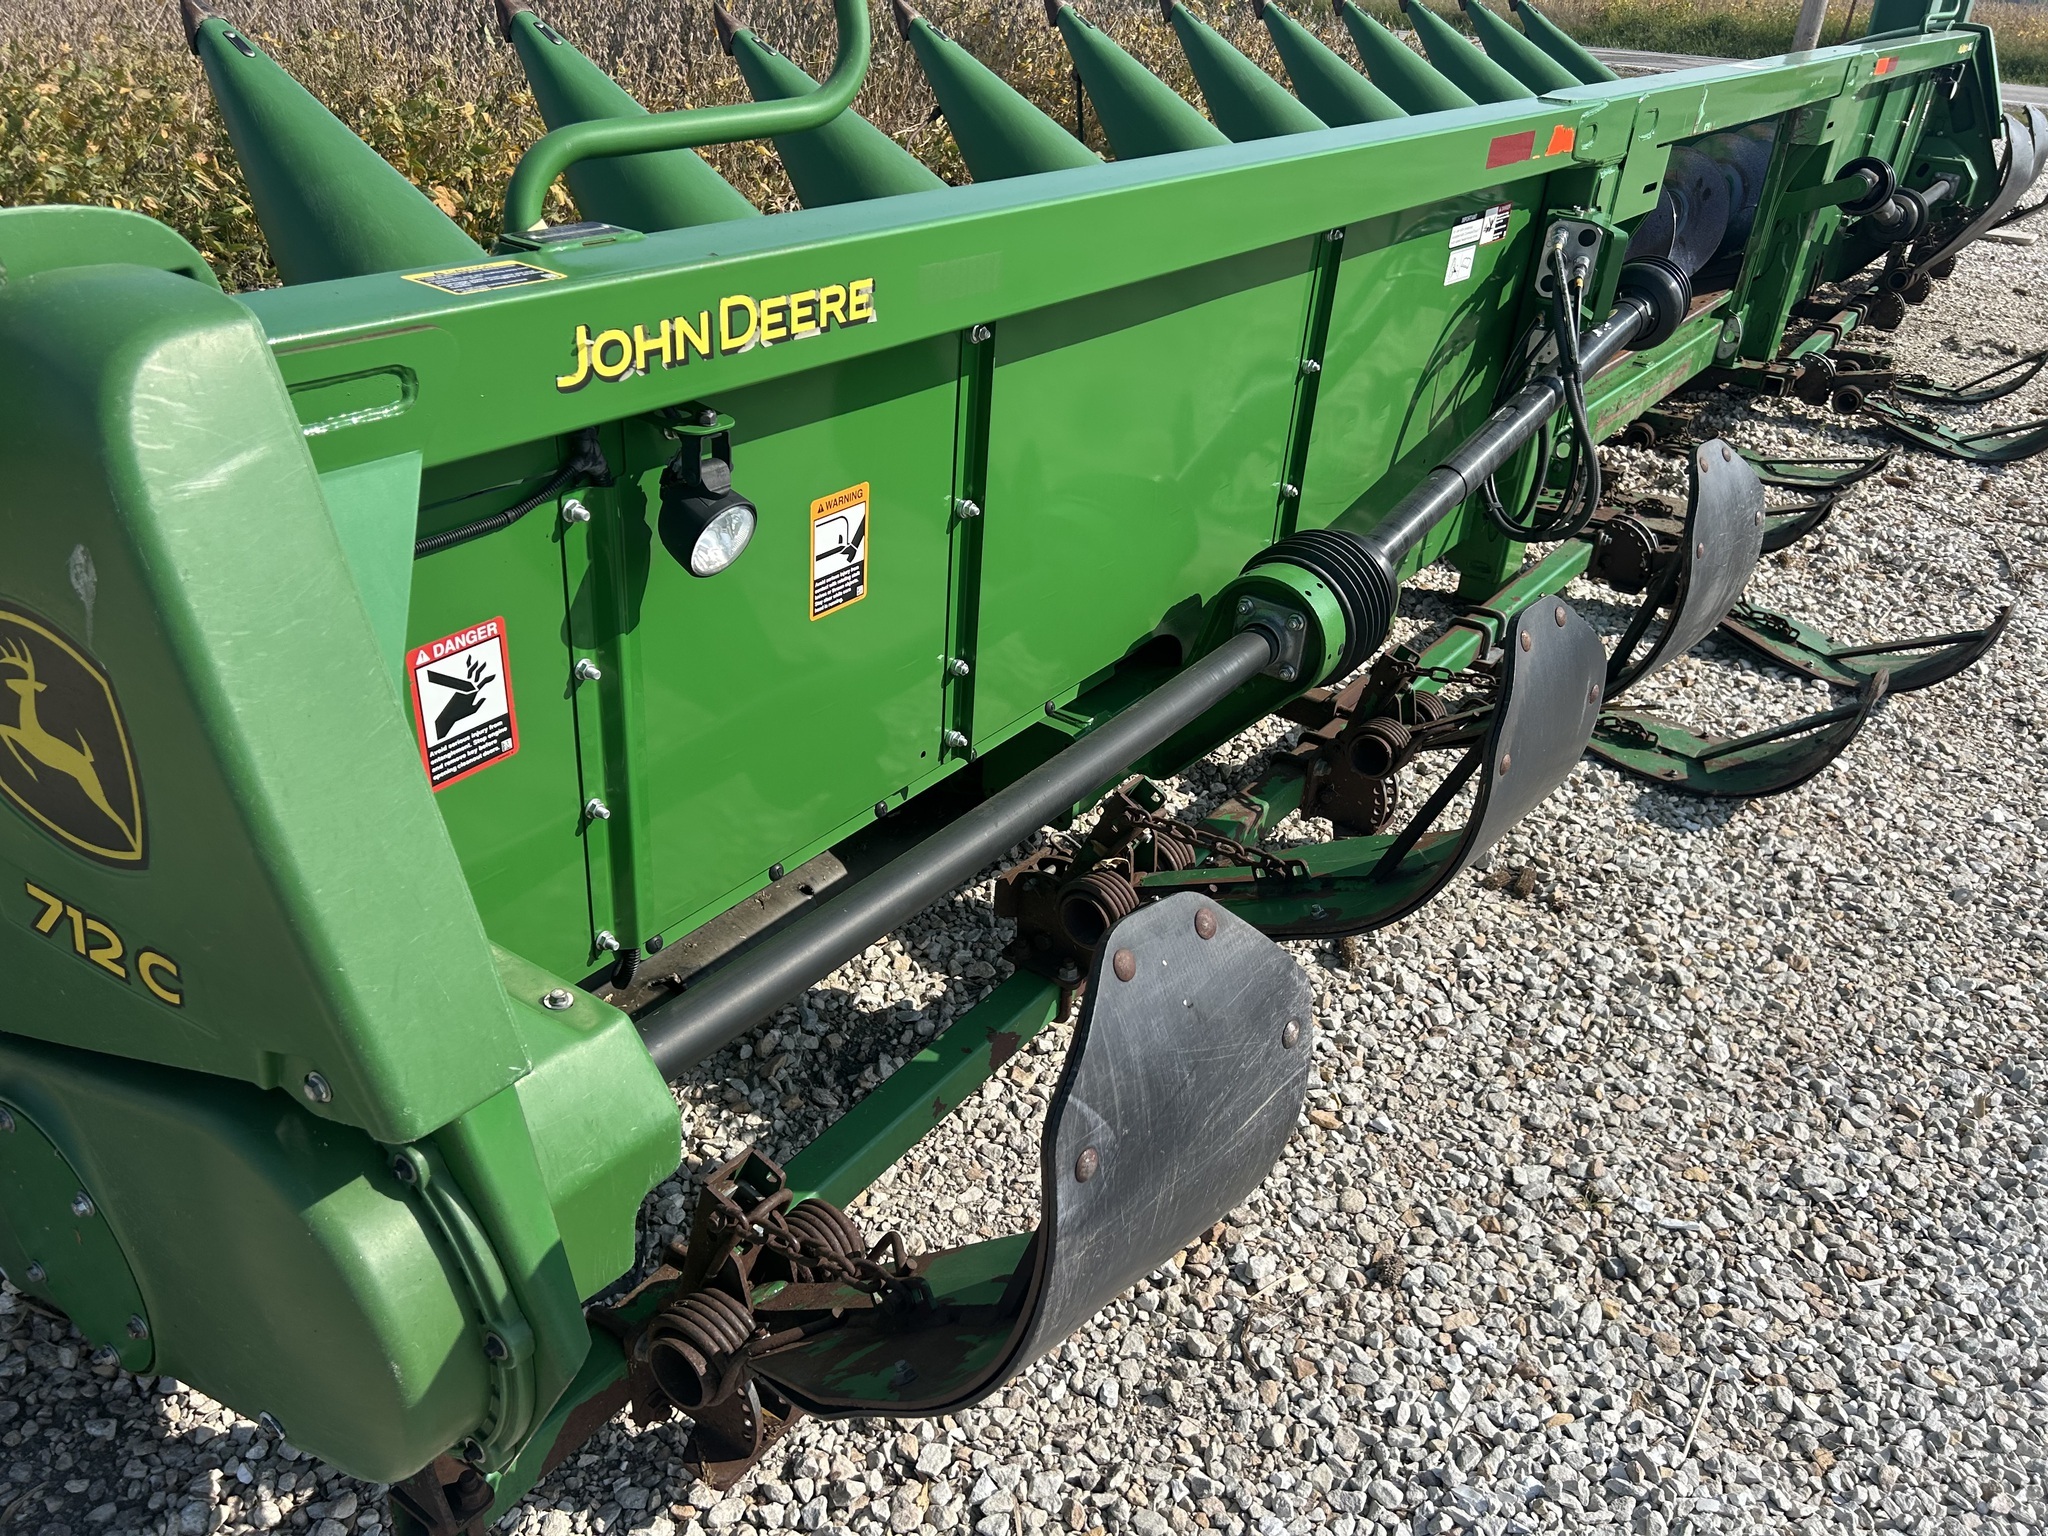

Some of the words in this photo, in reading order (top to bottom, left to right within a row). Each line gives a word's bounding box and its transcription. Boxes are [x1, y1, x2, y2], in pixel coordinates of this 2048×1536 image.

[556, 310, 711, 391] JOHN
[719, 278, 876, 354] DEERE
[825, 489, 863, 510] WARNING
[433, 622, 498, 658] DANGER
[430, 744, 448, 758] Avoid
[448, 736, 470, 749] serious
[471, 727, 488, 739] injury
[488, 721, 503, 730] from
[430, 743, 472, 765] entanglement.
[472, 736, 487, 746] Stop
[488, 726, 508, 738] engine
[431, 763, 444, 773] and
[444, 754, 466, 767] remove
[467, 748, 478, 756] key
[478, 739, 498, 751] before
[432, 766, 458, 780] opening
[457, 753, 482, 769] cleanout
[482, 746, 500, 757] doors.
[26, 880, 129, 981] 712
[137, 949, 182, 1006] C
